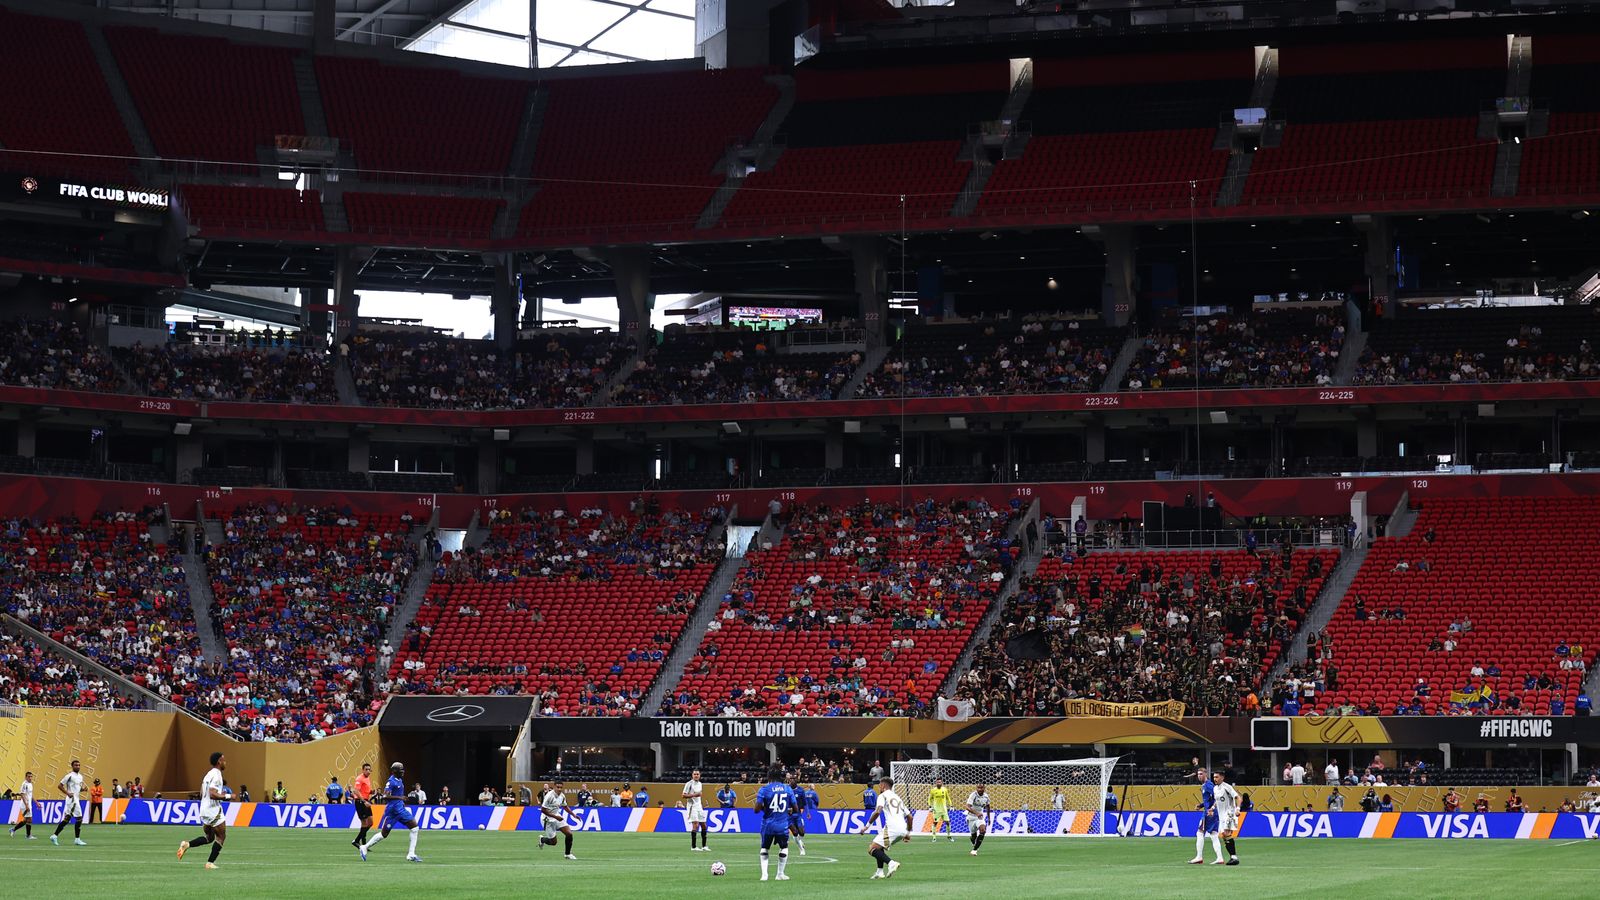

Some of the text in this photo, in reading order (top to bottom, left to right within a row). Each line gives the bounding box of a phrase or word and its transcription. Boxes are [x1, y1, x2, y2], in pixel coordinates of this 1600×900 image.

[59, 183, 89, 198] FIFA
[90, 186, 125, 202] CLUB
[1114, 303, 1129, 313] 223
[864, 312, 880, 321] 222
[337, 319, 351, 328] 221
[626, 321, 639, 329] 221
[1319, 391, 1354, 400] 224-225
[140, 400, 171, 410] 219-220
[1085, 397, 1119, 406] 223-224
[564, 412, 595, 420] 221-222
[1336, 481, 1352, 490] 119
[1412, 479, 1428, 488] 120
[147, 487, 161, 496] 116
[206, 490, 220, 499] 116
[1016, 487, 1032, 496] 118
[1089, 486, 1105, 495] 119
[716, 494, 731, 502] 117
[781, 492, 795, 501] 118
[418, 498, 432, 506] 116
[483, 499, 497, 508] 117
[1065, 702, 1082, 715] LOS
[1083, 702, 1112, 717] LOCOS
[659, 720, 796, 738] Take It To The World
[1480, 719, 1552, 738] #FIFACWC
[769, 793, 788, 813] 45
[38, 801, 65, 824] VIS
[143, 800, 202, 824] VISA
[269, 804, 329, 828] VISA
[1110, 812, 1180, 837] VISA
[1261, 813, 1333, 838] VISA
[1416, 813, 1489, 838] VISA
